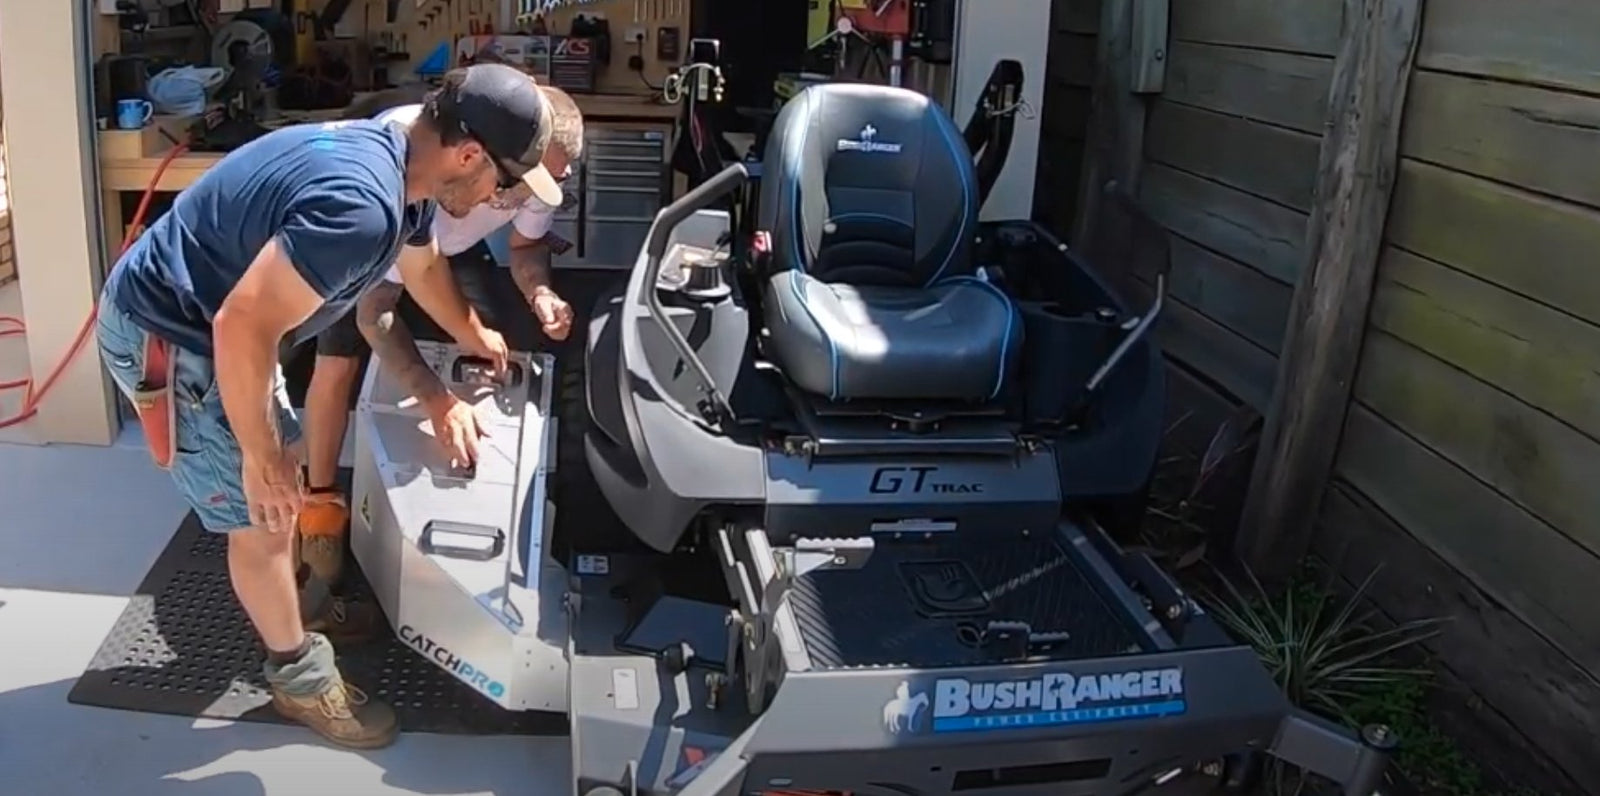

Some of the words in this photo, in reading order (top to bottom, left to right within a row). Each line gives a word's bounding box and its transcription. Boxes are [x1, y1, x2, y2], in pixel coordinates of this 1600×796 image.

[869, 467, 938, 494] GT
[931, 483, 984, 493] TRAC
[933, 668, 1183, 718] BUSHRANGER
